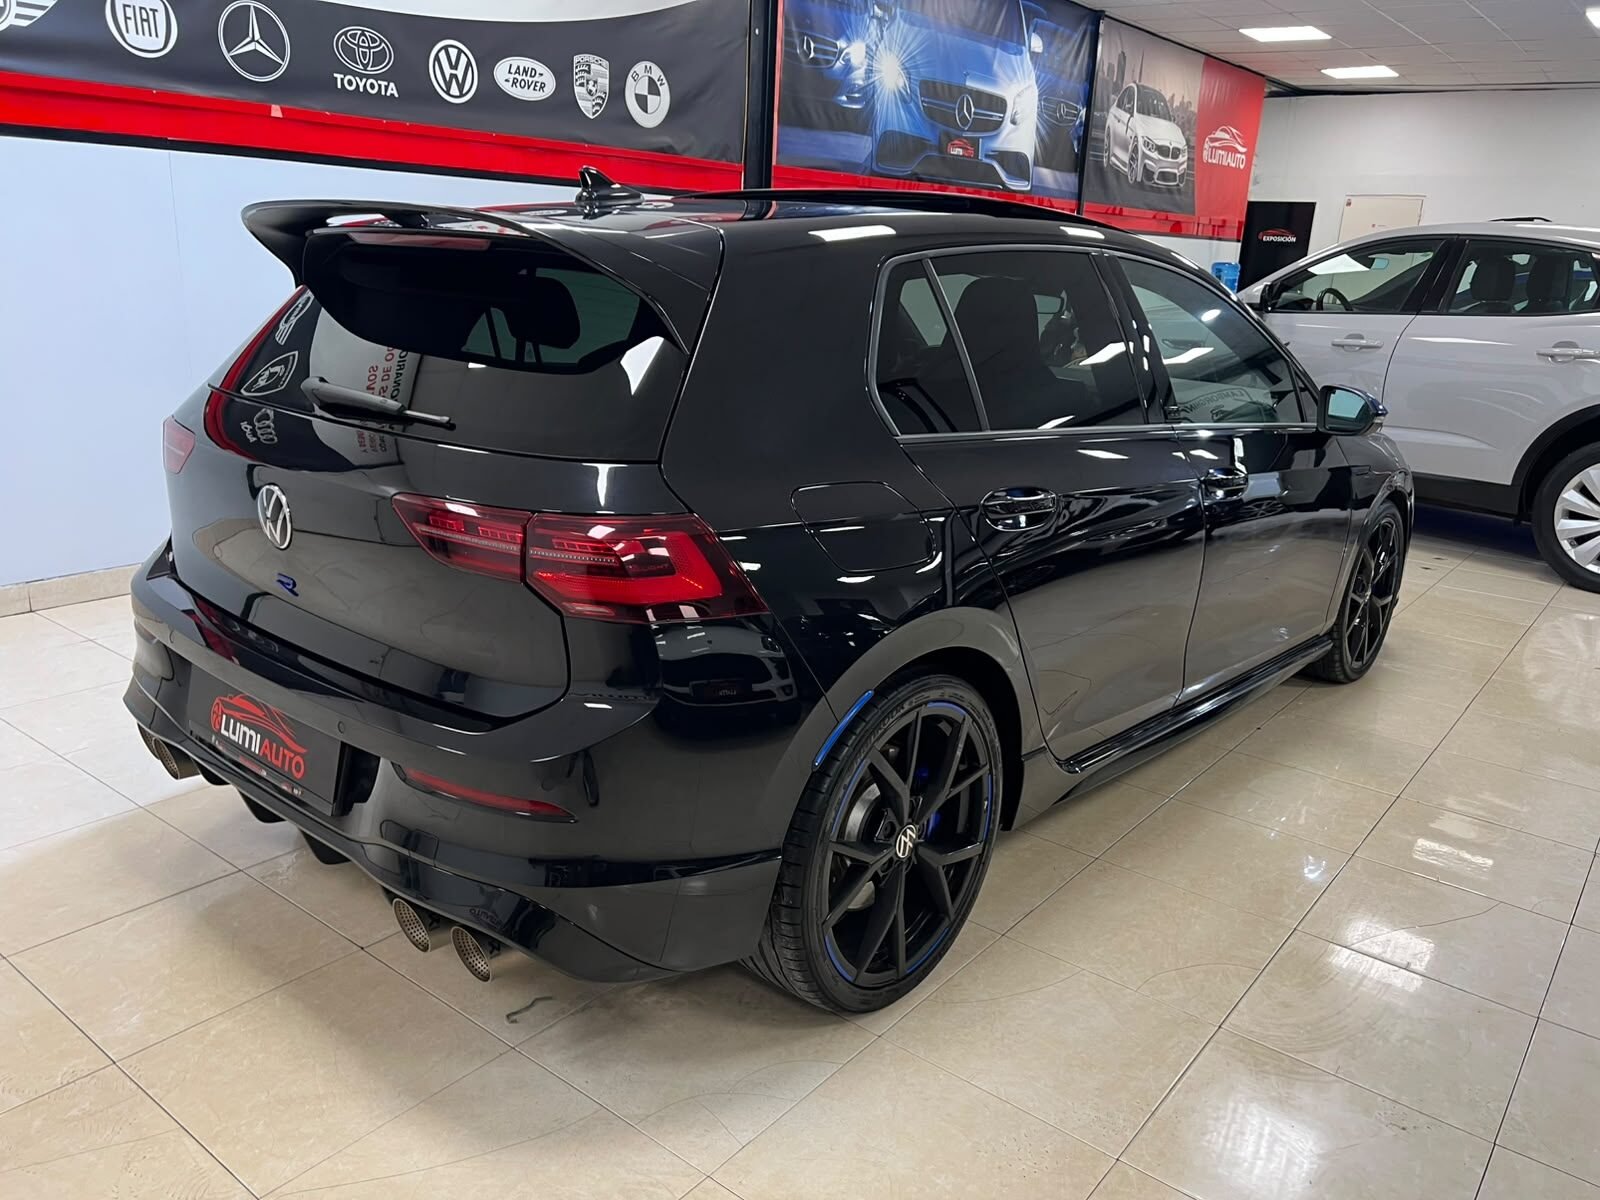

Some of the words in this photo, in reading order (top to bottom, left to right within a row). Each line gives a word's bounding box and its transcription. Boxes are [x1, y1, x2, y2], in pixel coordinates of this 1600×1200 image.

[122, 3, 159, 38] FIAT
[333, 73, 398, 98] TOYOTA
[631, 65, 665, 88] BMW
[276, 572, 299, 597] R
